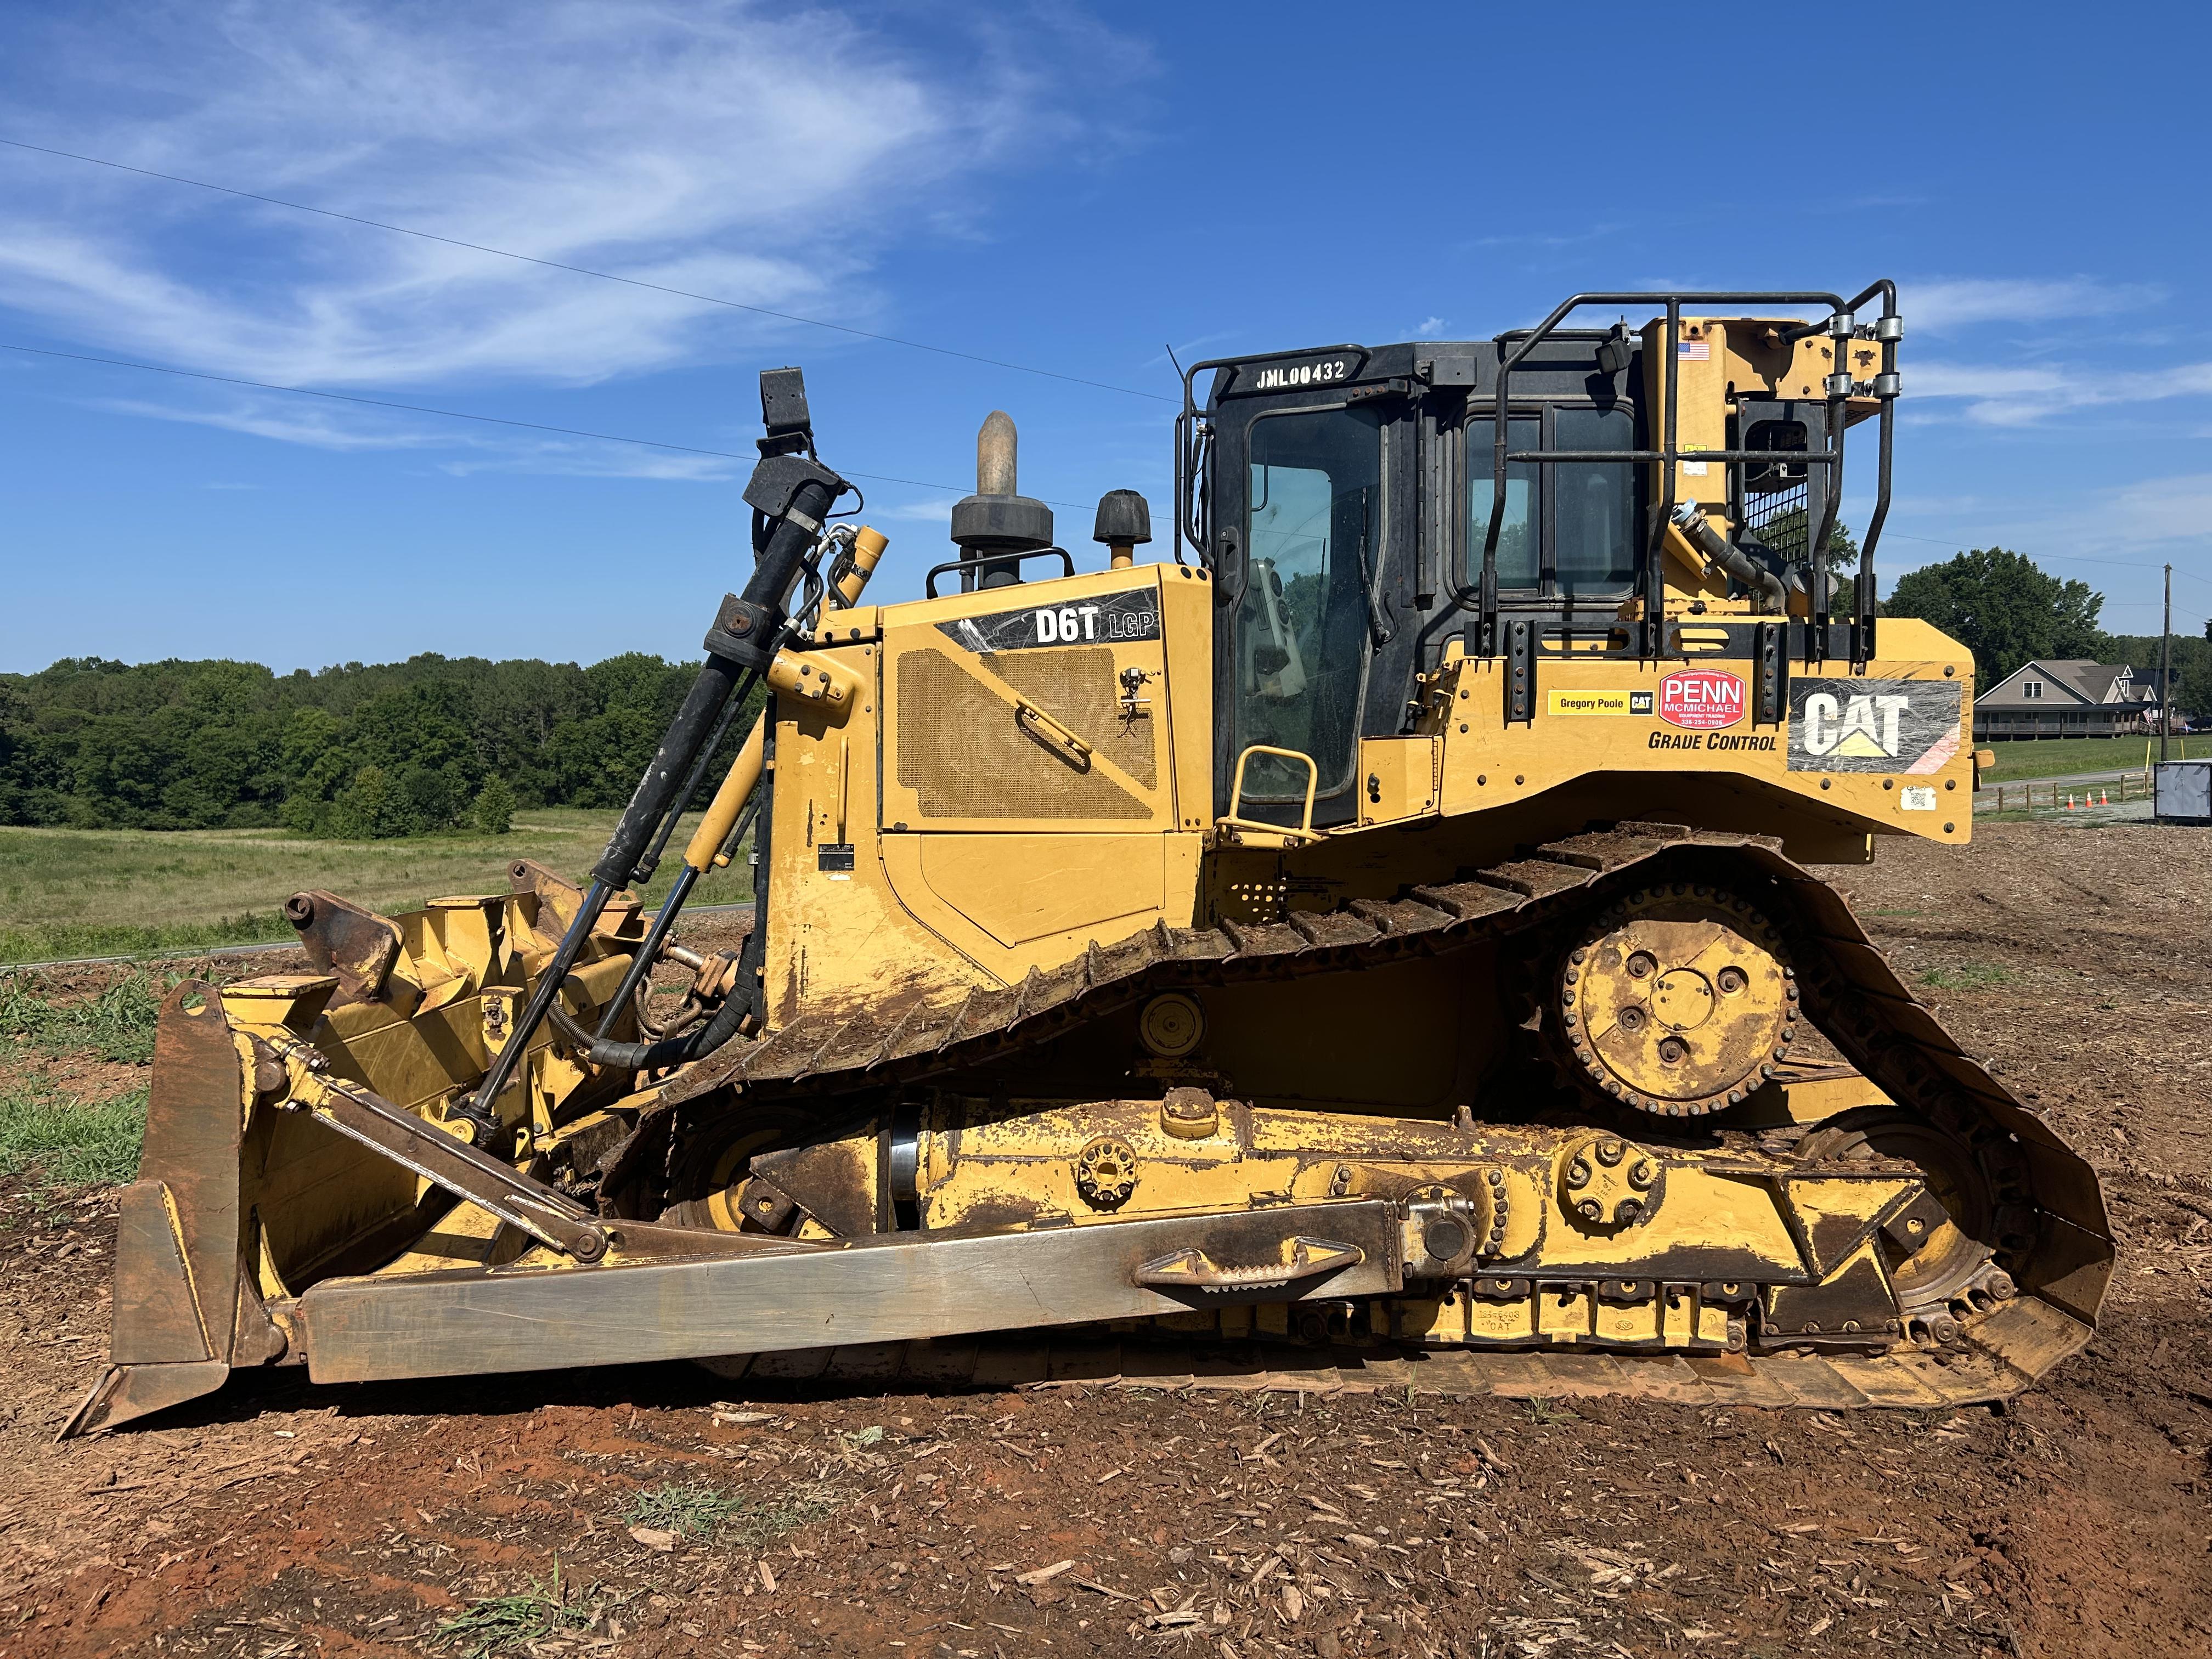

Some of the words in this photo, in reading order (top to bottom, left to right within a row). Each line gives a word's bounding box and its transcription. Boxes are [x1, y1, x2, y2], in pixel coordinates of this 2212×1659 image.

[1257, 360, 1344, 388] JML00432
[1036, 606, 1098, 643] D6T
[1109, 612, 1154, 638] LGP
[1665, 680, 1740, 703] PENN
[1560, 698, 1595, 709] Gregory
[1598, 699, 1623, 708] Poole
[1632, 697, 1652, 709] CAT
[1664, 703, 1740, 713] MCMICHAEL
[1804, 693, 1909, 757] CAT
[1648, 731, 1703, 749] GRADE
[1707, 732, 1776, 751] CONTROL
